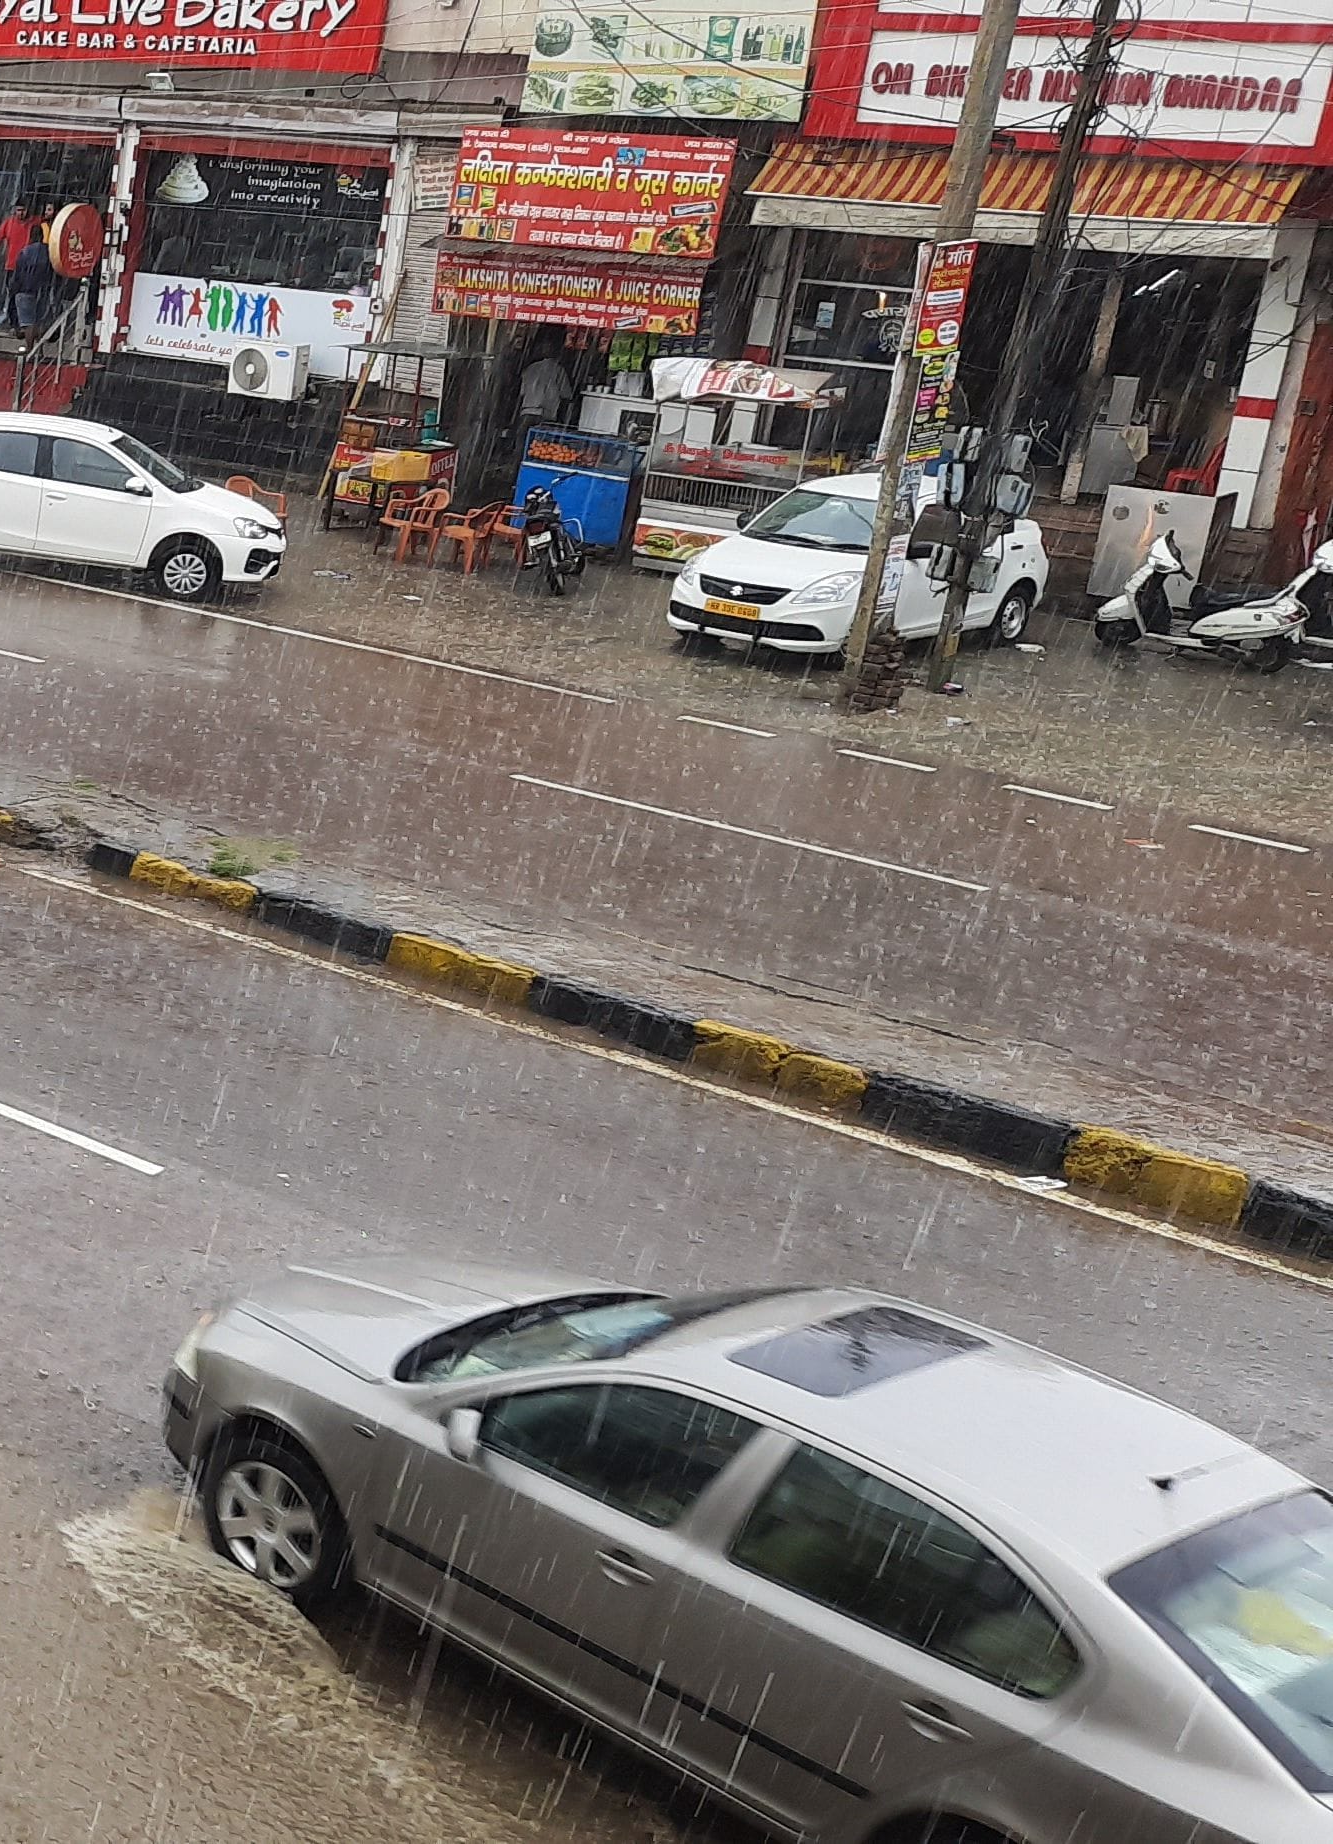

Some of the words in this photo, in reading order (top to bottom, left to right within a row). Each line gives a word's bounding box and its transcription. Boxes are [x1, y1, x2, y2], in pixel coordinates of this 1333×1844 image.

[175, 0, 355, 38] Bakery
[16, 30, 69, 48] CAKE
[76, 32, 115, 49] BAR
[123, 33, 136, 49] &
[144, 34, 257, 56] CAFETARIA
[871, 61, 914, 95] OM
[924, 63, 1033, 101] BIKER
[460, 150, 514, 184] लक्षिता
[616, 168, 632, 192] व
[634, 169, 671, 207] जूस
[458, 267, 509, 291] LAKSHITA
[512, 271, 603, 299] CONFECTIONERY
[605, 279, 613, 299] &
[616, 280, 651, 304] JUICE
[653, 282, 702, 308] CORNER
[144, 334, 164, 346] lets
[430, 453, 455, 476] OFFEE
